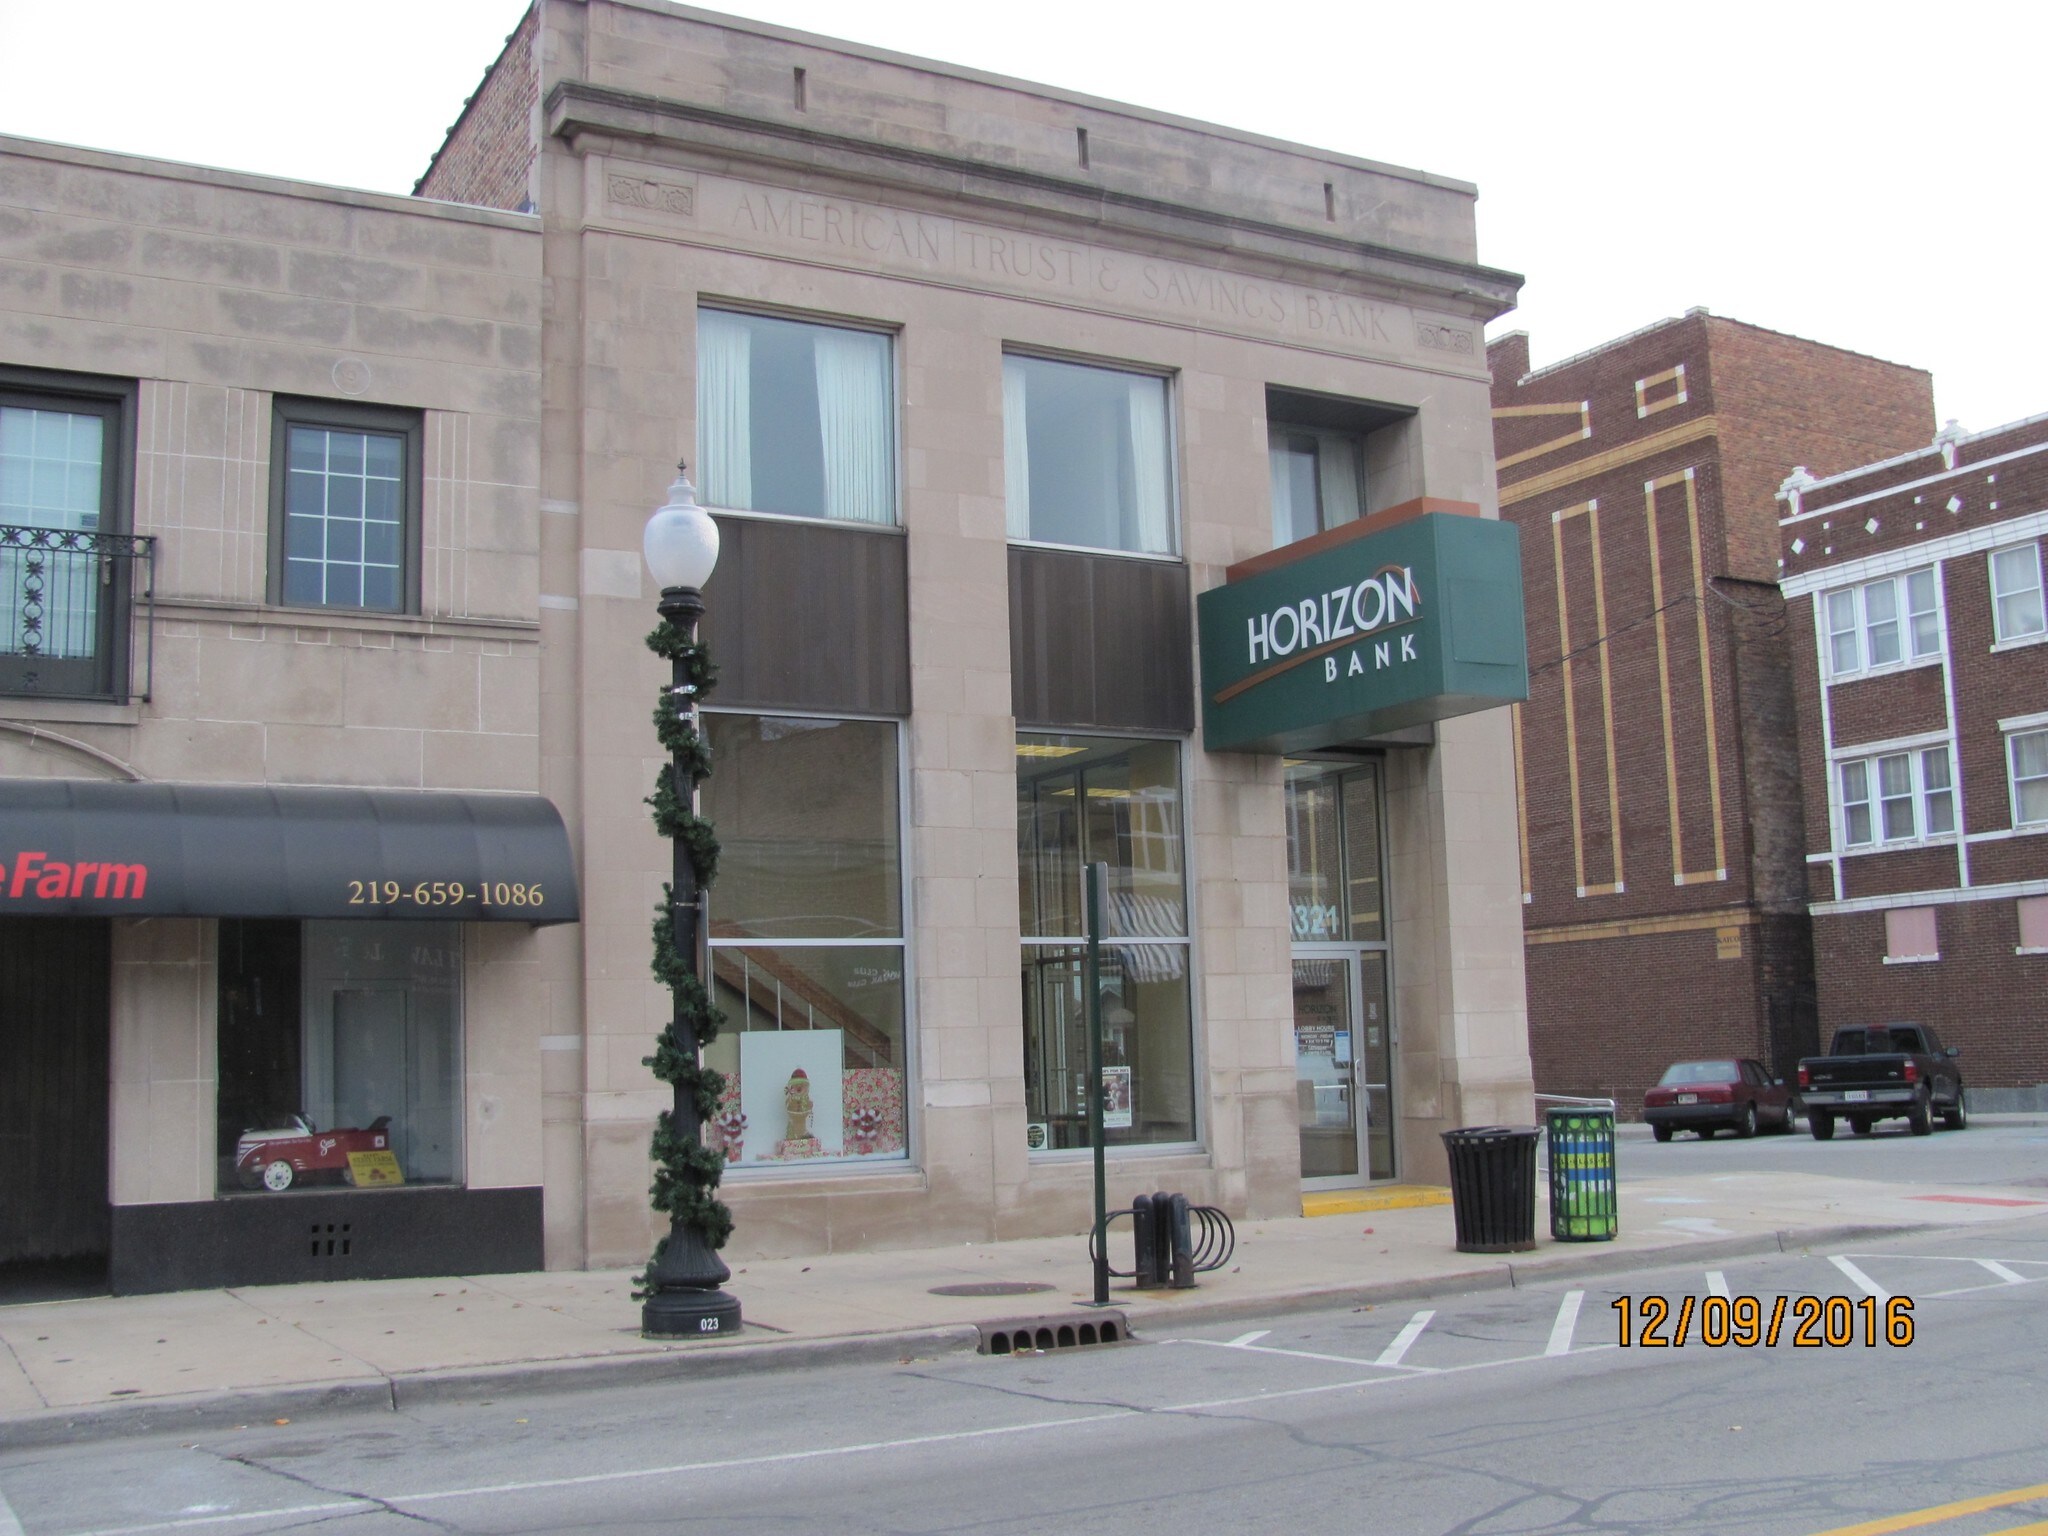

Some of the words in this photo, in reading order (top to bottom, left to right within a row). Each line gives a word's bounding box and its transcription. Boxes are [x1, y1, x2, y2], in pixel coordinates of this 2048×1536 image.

[732, 193, 940, 262] AMERICAN
[961, 230, 1081, 287] TRUST
[1098, 257, 1121, 292] &
[1142, 264, 1286, 323] SAVINGS
[1305, 294, 1390, 343] BANK
[1248, 567, 1414, 664] HORIZON
[1325, 634, 1417, 683] BANK
[9, 851, 148, 899] Farm
[348, 880, 545, 906] 219-659-1086
[1289, 905, 1337, 934] 321
[700, 1317, 719, 1330] 023
